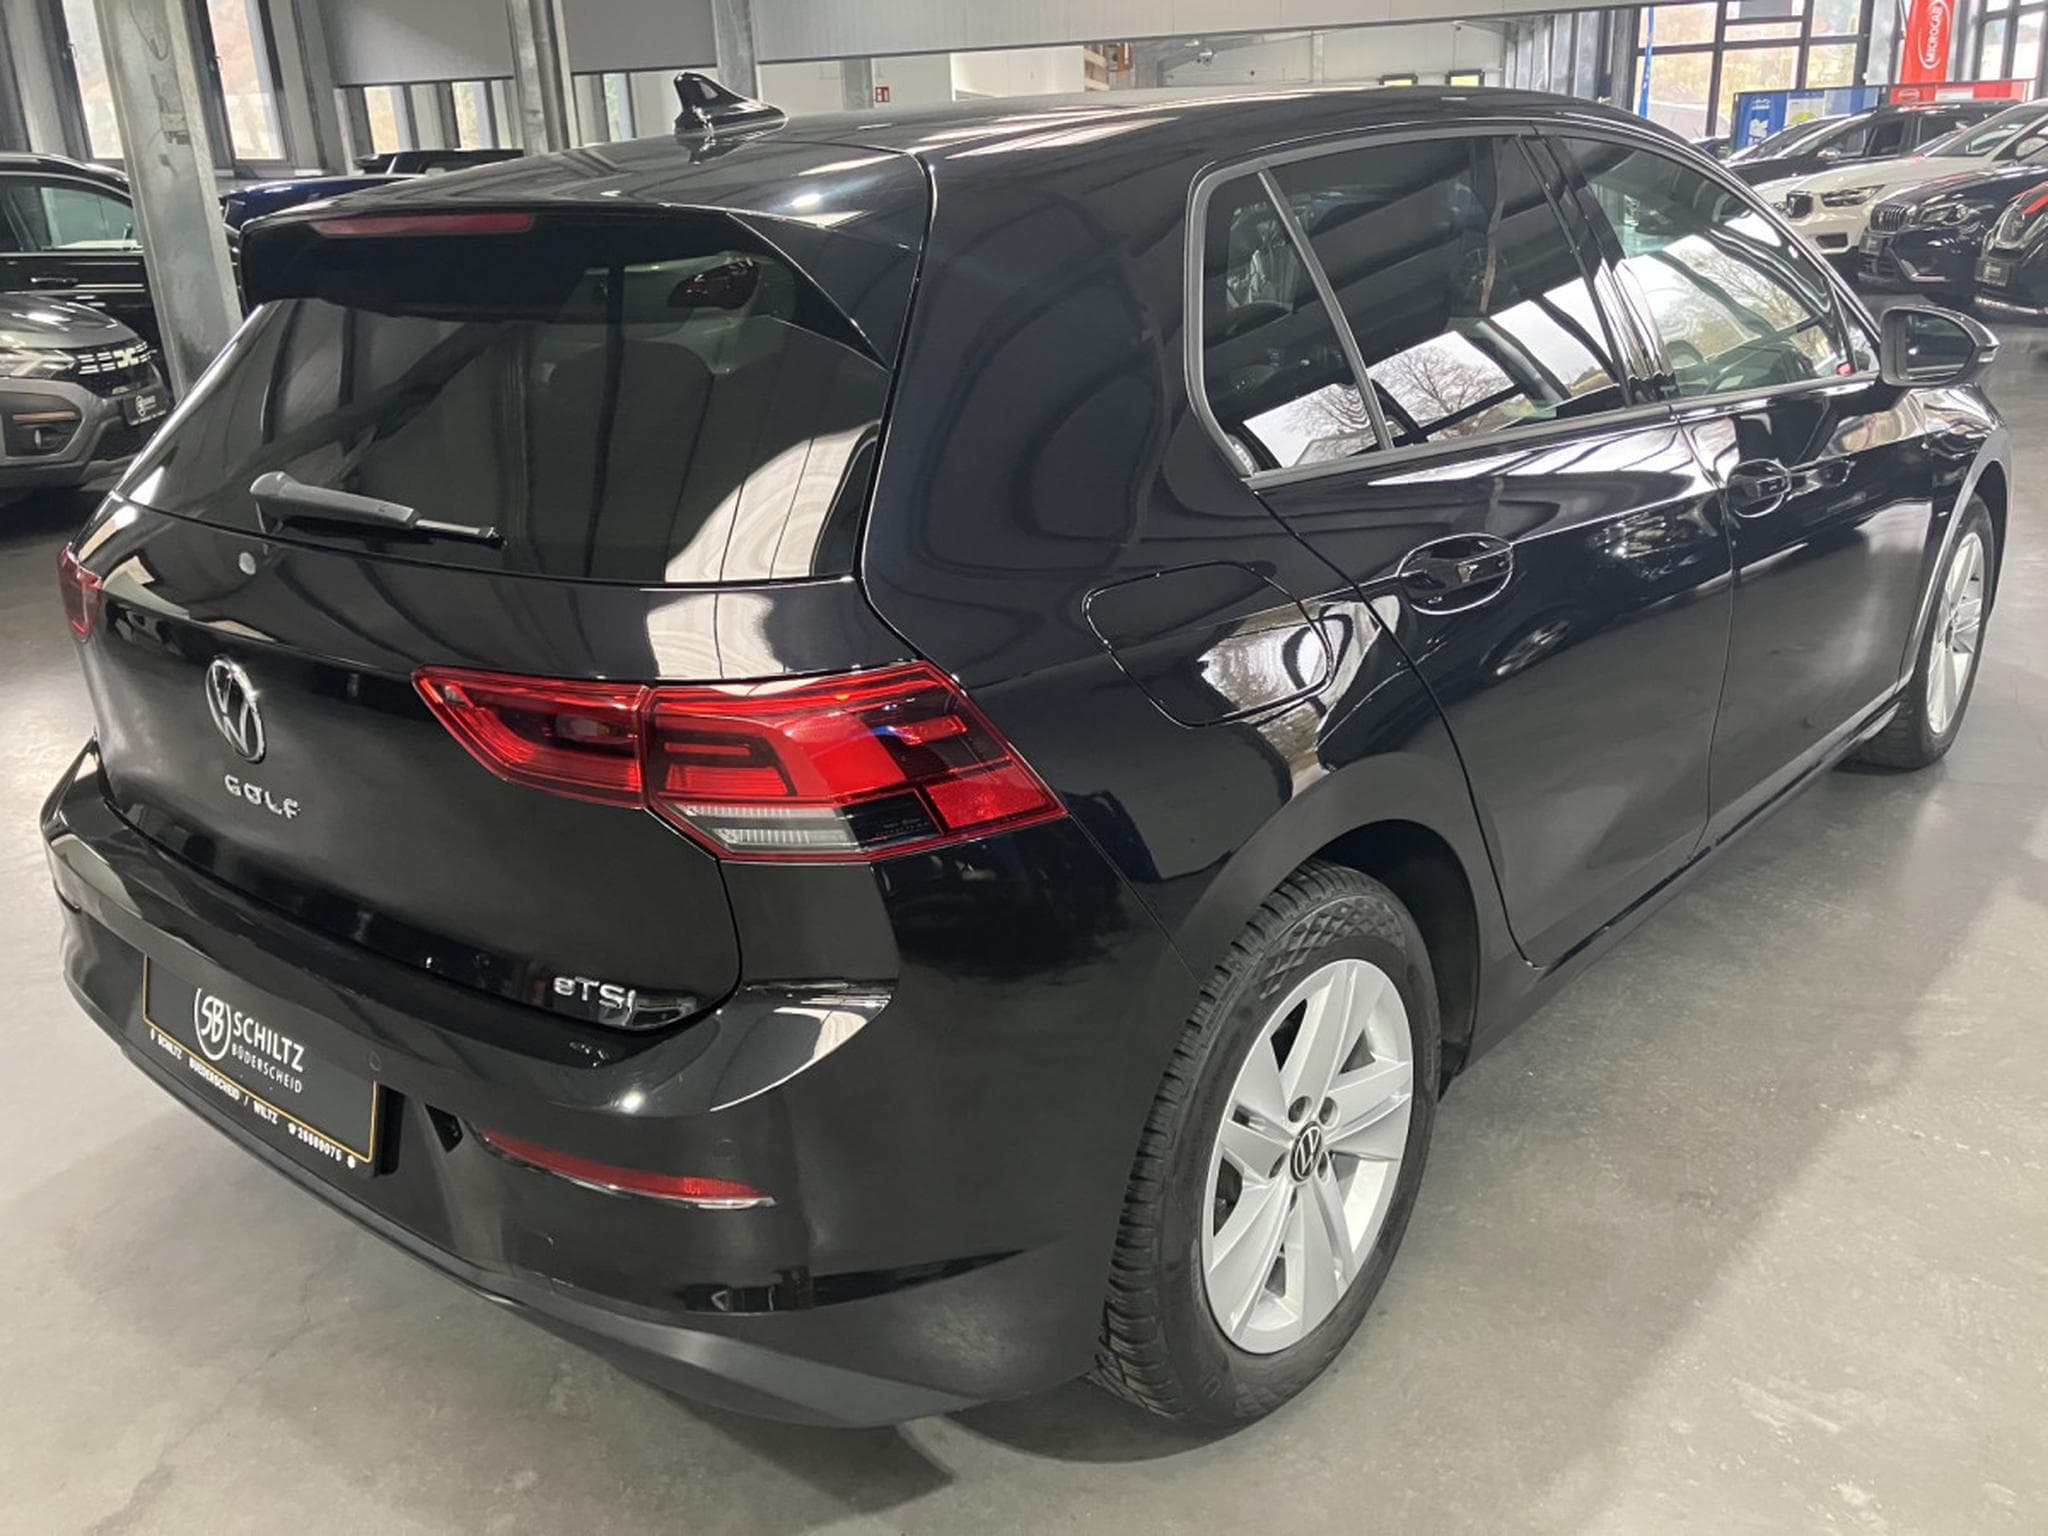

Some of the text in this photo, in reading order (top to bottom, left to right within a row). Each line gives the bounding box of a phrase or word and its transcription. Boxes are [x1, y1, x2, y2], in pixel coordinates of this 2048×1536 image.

[224, 773, 301, 819] GOLF
[553, 976, 637, 1009] eTSI
[232, 1010, 305, 1073] SCHILTZ
[231, 1043, 303, 1094] BÜDERSCHEID
[253, 1100, 279, 1126] WILTZ
